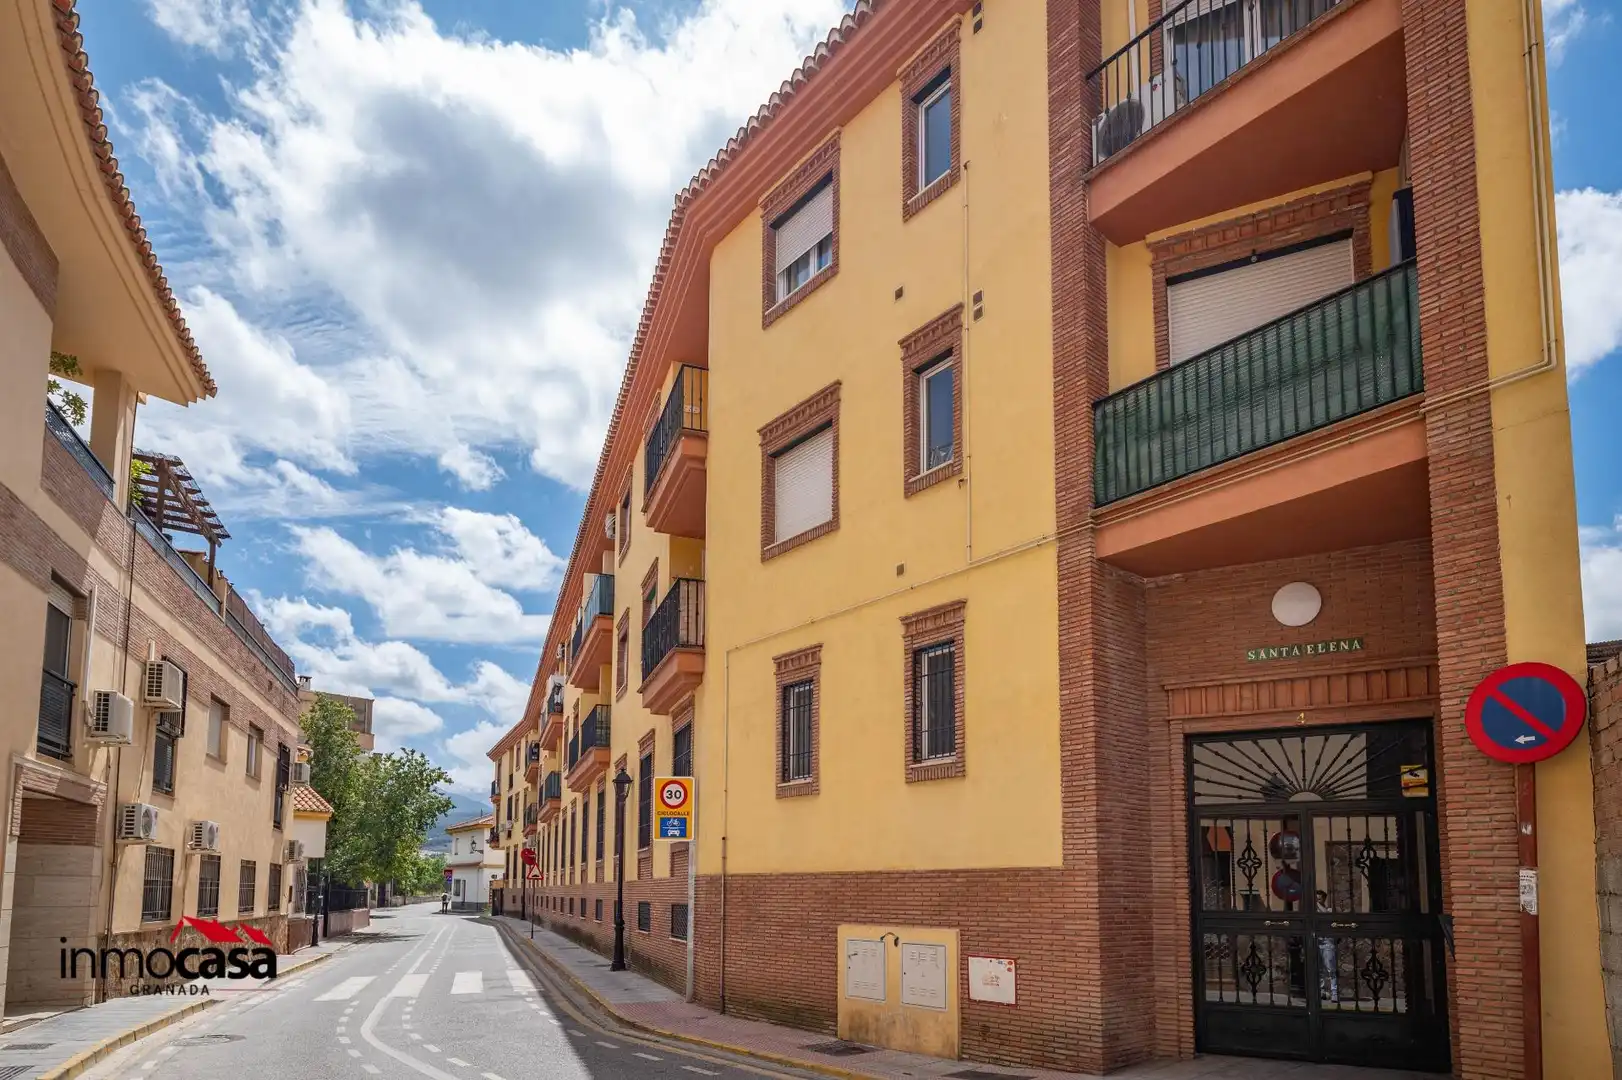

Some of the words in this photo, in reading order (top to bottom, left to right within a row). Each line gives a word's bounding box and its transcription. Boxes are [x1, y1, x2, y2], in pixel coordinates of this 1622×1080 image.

[1247, 645, 1300, 660] SANTA
[1306, 639, 1361, 654] ELENA
[665, 789, 682, 800] 30
